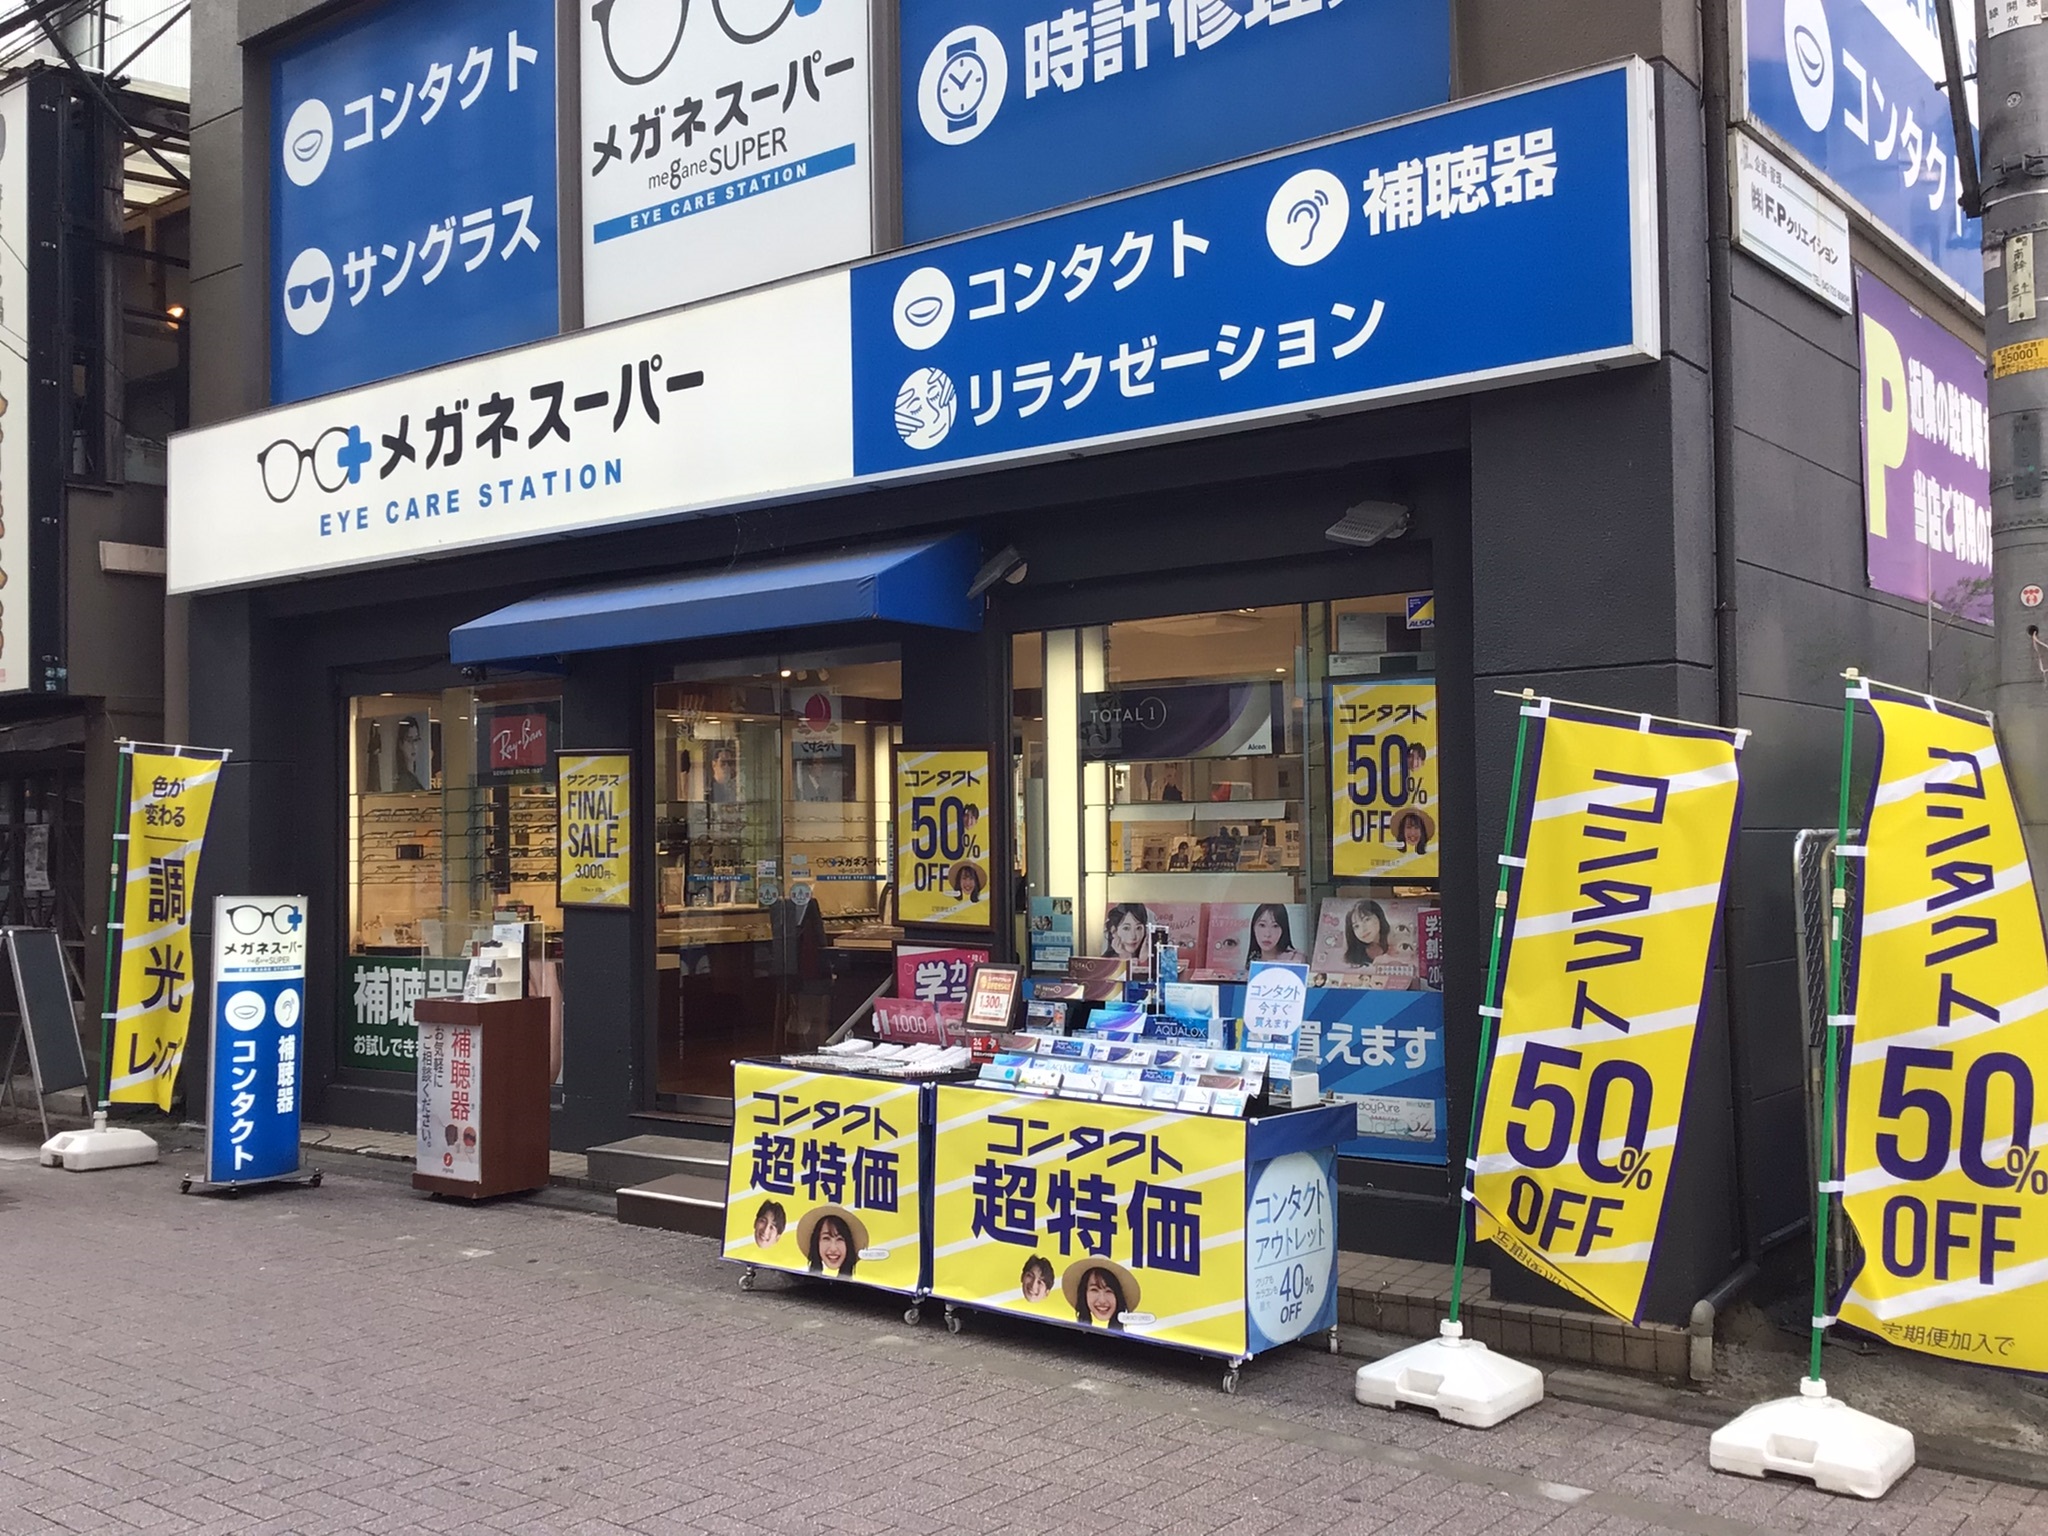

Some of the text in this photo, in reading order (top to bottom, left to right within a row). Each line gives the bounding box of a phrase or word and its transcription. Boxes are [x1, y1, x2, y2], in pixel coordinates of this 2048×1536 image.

[1025, 0, 1344, 99] 時計修
[344, 30, 538, 151] コンタクト
[592, 50, 854, 177] メガネスーパー
[630, 162, 808, 230] EYE CARE STATION
[1363, 127, 1558, 236] 補聴器
[343, 195, 540, 307] サングラス
[969, 218, 1209, 321] コンタクト
[969, 299, 1385, 426] リラクゼーション
[380, 354, 704, 480] メガネスーパー
[1863, 313, 1909, 538] P
[320, 459, 622, 536] EYE CARE STATION
[1090, 708, 1144, 723] TOTAL
[1340, 704, 1427, 725] コンタクト
[151, 775, 185, 798] 色が
[567, 774, 619, 787] サングラス
[905, 770, 980, 788] コンタクト
[1347, 734, 1428, 807] 50%
[145, 804, 185, 827] 変わる
[568, 791, 619, 820] FINAL
[911, 796, 980, 861] 50%
[1352, 810, 1391, 842] OFF
[568, 823, 619, 858] SALE
[914, 862, 950, 892] OFF
[1566, 769, 1670, 1034] コンタクト
[1924, 746, 2001, 1027] コンタクト
[224, 941, 302, 955] メガネスーパー
[1425, 915, 1438, 959] 学割
[915, 961, 948, 1002] 学
[1250, 984, 1301, 999] コンタクト
[1258, 1002, 1291, 1015] 今すぐ
[1155, 1024, 1207, 1038] AQUALOX
[1253, 1017, 1291, 1029] 買えます
[1298, 1021, 1436, 1069] 買えます
[276, 1035, 295, 1114] 補聴器
[450, 1027, 471, 1121] 補聴器
[229, 1040, 257, 1170] コンタクト
[752, 1092, 898, 1140] コンタクト
[1505, 1041, 1654, 1191] 50%
[1876, 1045, 2048, 1196] 50%
[750, 1132, 899, 1212] 超特価
[987, 1114, 1183, 1174] コンタクト
[973, 1159, 1202, 1276] 超特価
[1256, 1179, 1325, 1225] コンタクト
[1506, 1175, 1624, 1257] OFF
[1256, 1218, 1326, 1263] アウトレット
[1882, 1195, 2022, 1285] OFF
[1279, 1264, 1314, 1302] 40%
[1280, 1301, 1303, 1324] OFF
[1882, 1322, 2016, 1356] 定期便加入で
